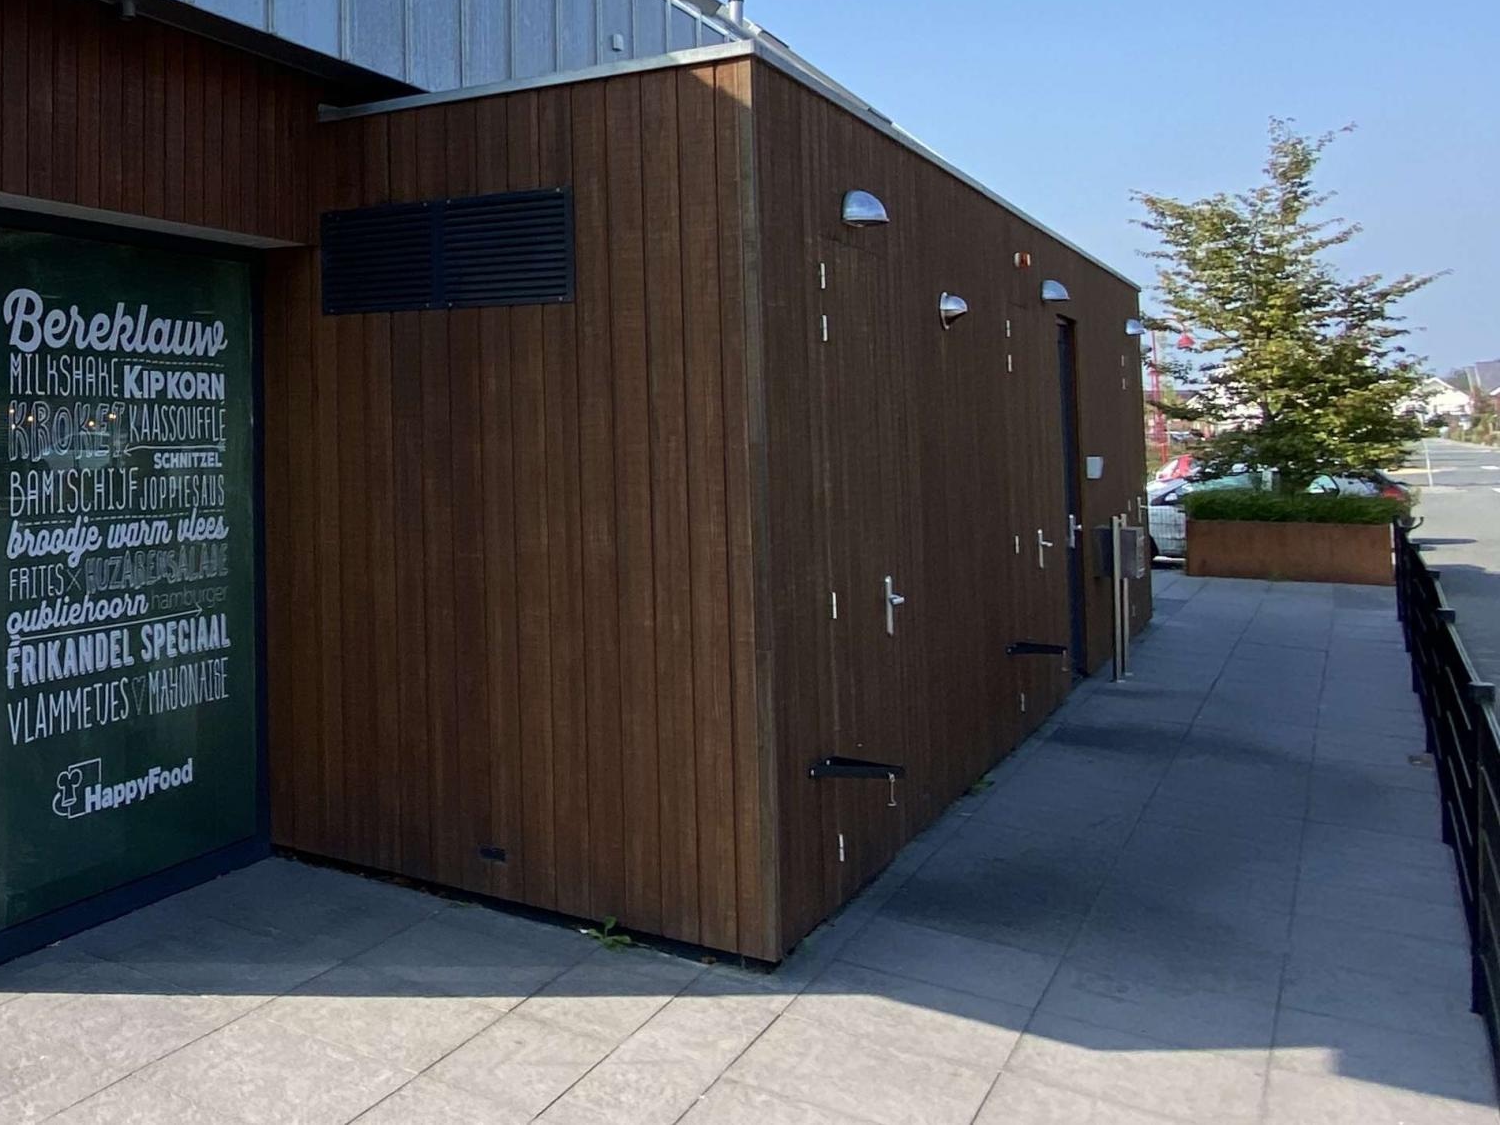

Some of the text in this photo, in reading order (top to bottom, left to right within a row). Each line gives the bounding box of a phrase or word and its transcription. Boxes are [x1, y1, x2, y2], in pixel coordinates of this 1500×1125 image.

[3, 288, 228, 357] Bereklauw
[9, 353, 225, 401] MILKSHAKE KIPKORN
[8, 400, 126, 462] KROKET
[153, 451, 222, 469] SCHNITZEL
[10, 466, 225, 518] BAMISCHIJF JOPPIESAUS
[6, 508, 229, 568] broodje warm vlees
[6, 584, 228, 636] oubliehoorn hamburger
[8, 563, 65, 602] FRITES
[6, 613, 232, 690] FRIKANDEL SPECIAAL
[7, 657, 229, 746] VLAMMETJES MAYONAISE
[85, 757, 193, 814] HappyFood
